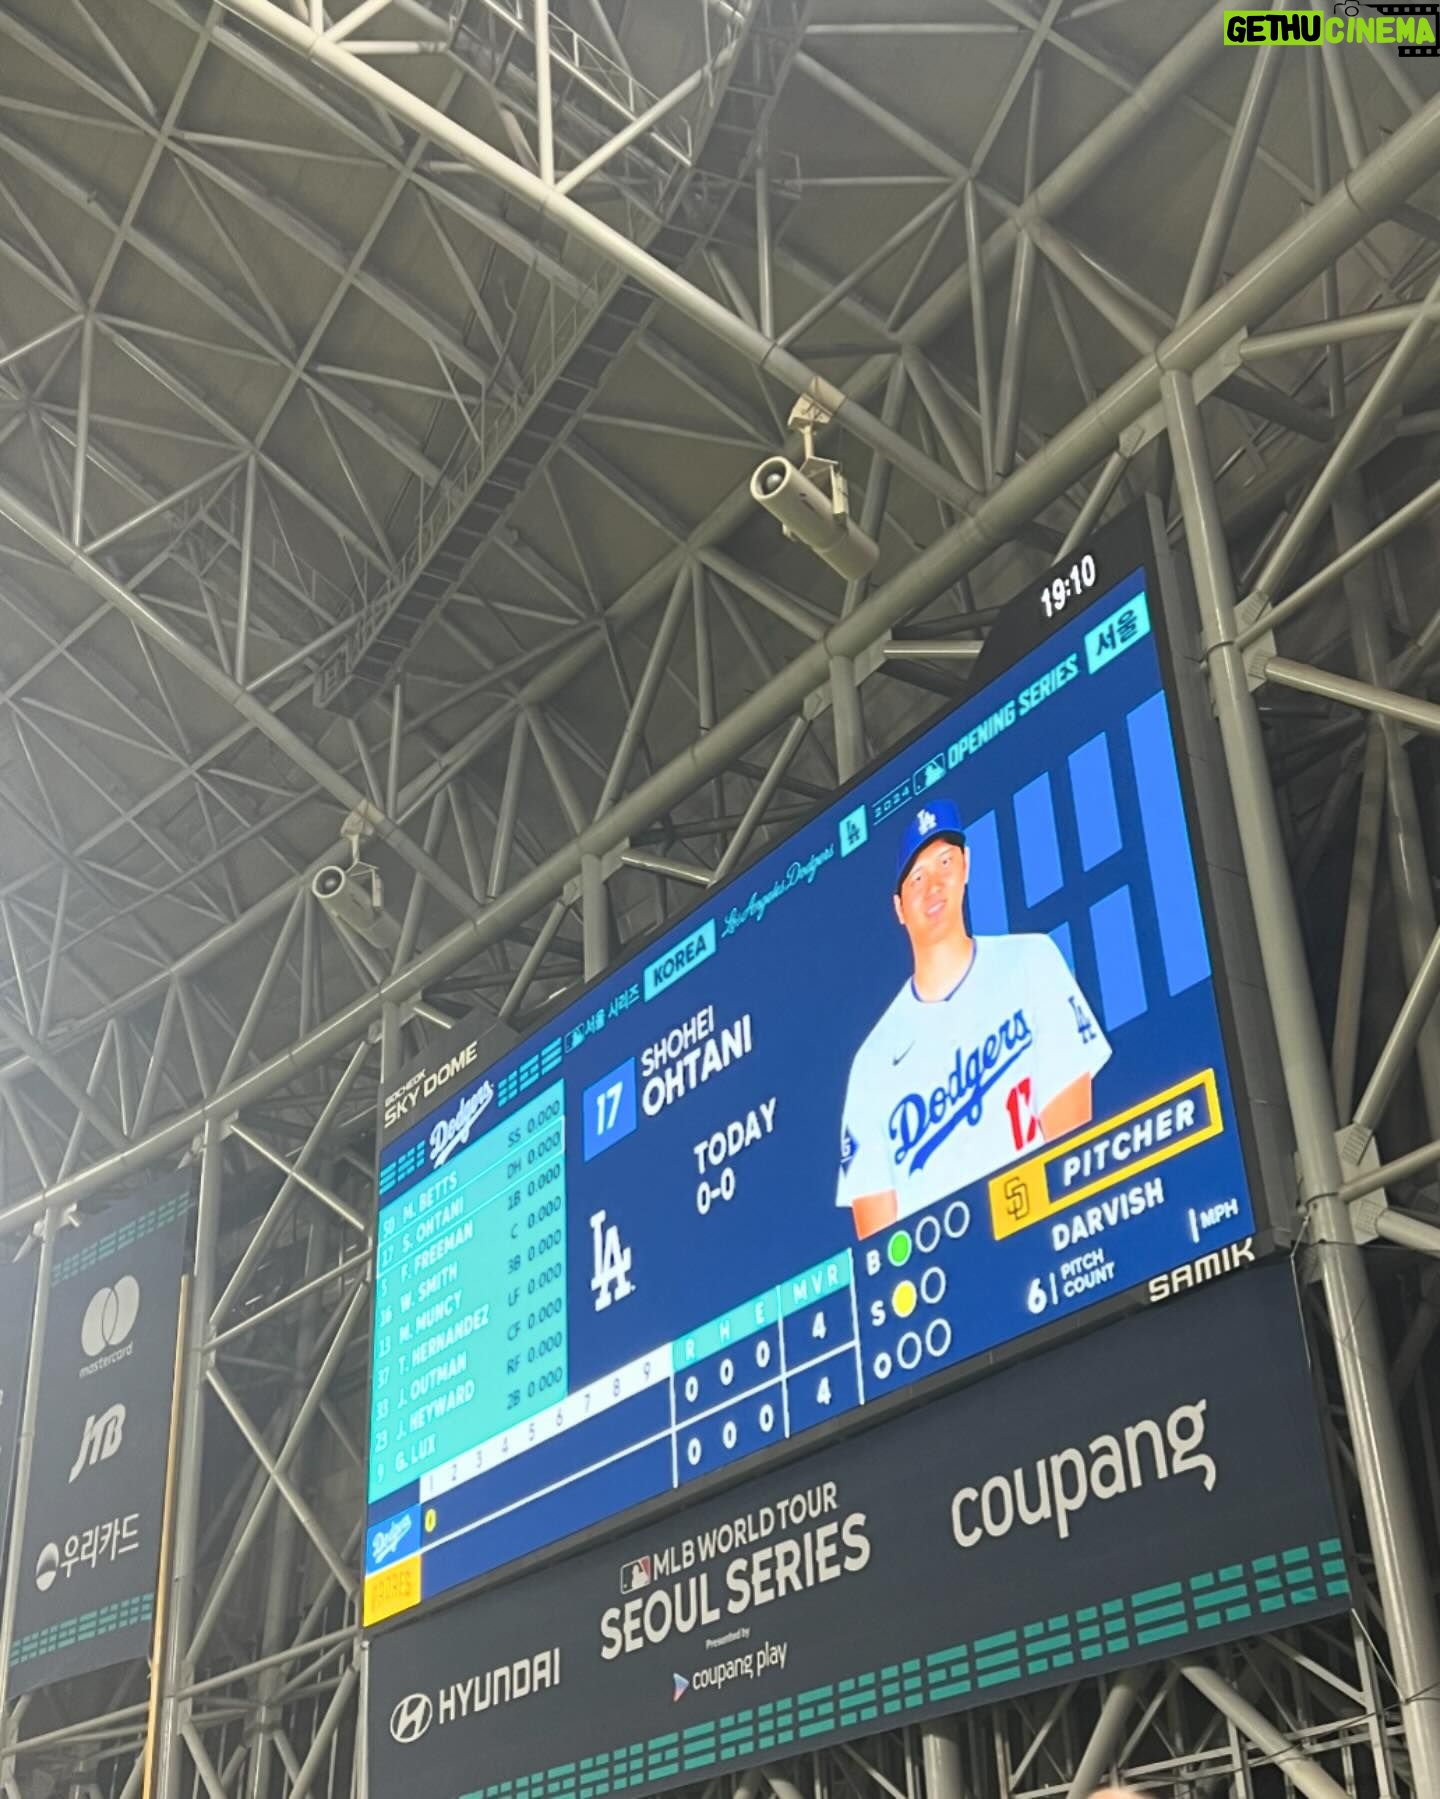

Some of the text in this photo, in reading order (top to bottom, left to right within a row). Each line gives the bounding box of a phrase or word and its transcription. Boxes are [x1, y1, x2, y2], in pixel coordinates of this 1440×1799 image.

[1040, 554, 1097, 618] 19:10
[1094, 608, 1139, 657] 서울
[946, 653, 1080, 770] OPENING SERIES
[786, 843, 834, 884] Dodgers
[652, 934, 708, 988] KOREA
[383, 1040, 479, 1129] SKY DOME
[640, 1005, 715, 1078] SHOHEI
[641, 1013, 753, 1117] OHTANI
[429, 1080, 494, 1169] Dodgers
[595, 1081, 624, 1136] 17
[693, 1096, 777, 1175] TODAY
[888, 1008, 1033, 1178] Dodgers
[418, 1171, 459, 1211] BETTS
[527, 1099, 561, 1136] 0.000
[1062, 1097, 1195, 1187] PITCHER
[382, 1244, 394, 1268] 17
[416, 1196, 464, 1243] OHTANI
[527, 1130, 561, 1167] 0.000
[414, 1219, 474, 1275] FREEMAN
[527, 1163, 561, 1199] 0.000
[696, 1166, 736, 1216] 0-0
[1051, 1176, 1165, 1252] DARVISH
[1200, 1197, 1240, 1231] MPH
[415, 1289, 463, 1334] MUNCY
[527, 1228, 562, 1264] 0.000
[418, 1261, 458, 1302] SMITH
[527, 1195, 562, 1231] 0.000
[866, 1250, 881, 1276] B
[1060, 1247, 1106, 1281] PITCH
[1063, 1261, 1116, 1299] COUNT
[1147, 1236, 1257, 1304] SAMIK
[411, 1303, 490, 1368] HERNANDEZ
[527, 1262, 562, 1297] 0.000
[613, 1377, 621, 1397] 8
[643, 1362, 651, 1382] 9
[685, 1338, 696, 1361] R
[720, 1319, 731, 1340] H
[756, 1302, 765, 1325] E
[793, 1264, 839, 1305] MVR
[871, 1300, 886, 1327] S
[1026, 1278, 1048, 1316] 6
[79, 1340, 134, 1379] mastercard
[408, 1379, 476, 1433] HEYWARD
[527, 1330, 562, 1365] 0.000
[410, 1351, 468, 1400] OUTMAN
[527, 1296, 562, 1331] 0.000
[410, 1433, 437, 1465] LUX
[527, 1366, 563, 1400] 0.000
[424, 1508, 437, 1533] 0
[685, 1376, 699, 1402] 0
[719, 1358, 734, 1386] 0
[756, 1340, 770, 1368] 0
[812, 1311, 827, 1339] 4
[687, 1437, 701, 1465] 0
[722, 1421, 737, 1449] 0
[759, 1404, 774, 1432] 0
[816, 1376, 831, 1405] 4
[951, 1398, 1218, 1548] coupang
[60, 1512, 141, 1579] 우리카드
[653, 1481, 839, 1582] MLB WORLD TOUR
[600, 1511, 872, 1661] SEOUL SERIES
[438, 1647, 562, 1726] HYUNDAI
[692, 1640, 788, 1690] coupang play
